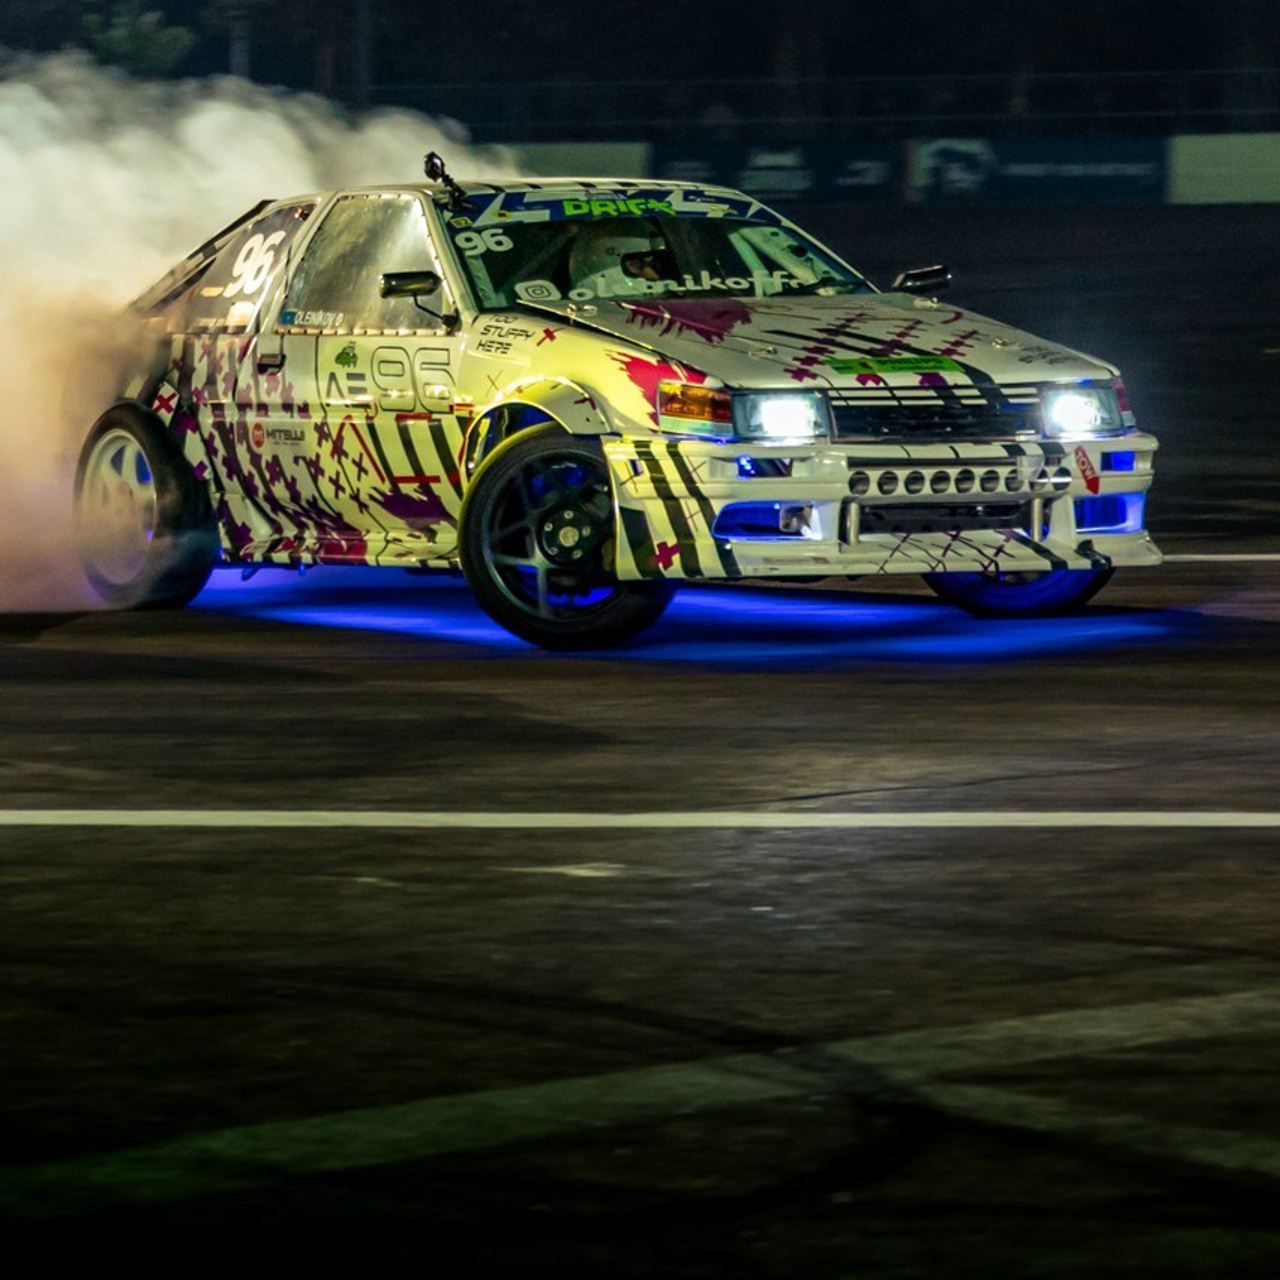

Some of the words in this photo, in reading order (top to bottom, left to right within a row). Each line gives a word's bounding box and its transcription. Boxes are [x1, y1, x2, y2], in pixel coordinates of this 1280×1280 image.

[454, 228, 514, 257] 96
[222, 230, 287, 298] 96
[481, 324, 536, 340] STUFFY
[1074, 448, 1100, 480] TOW
